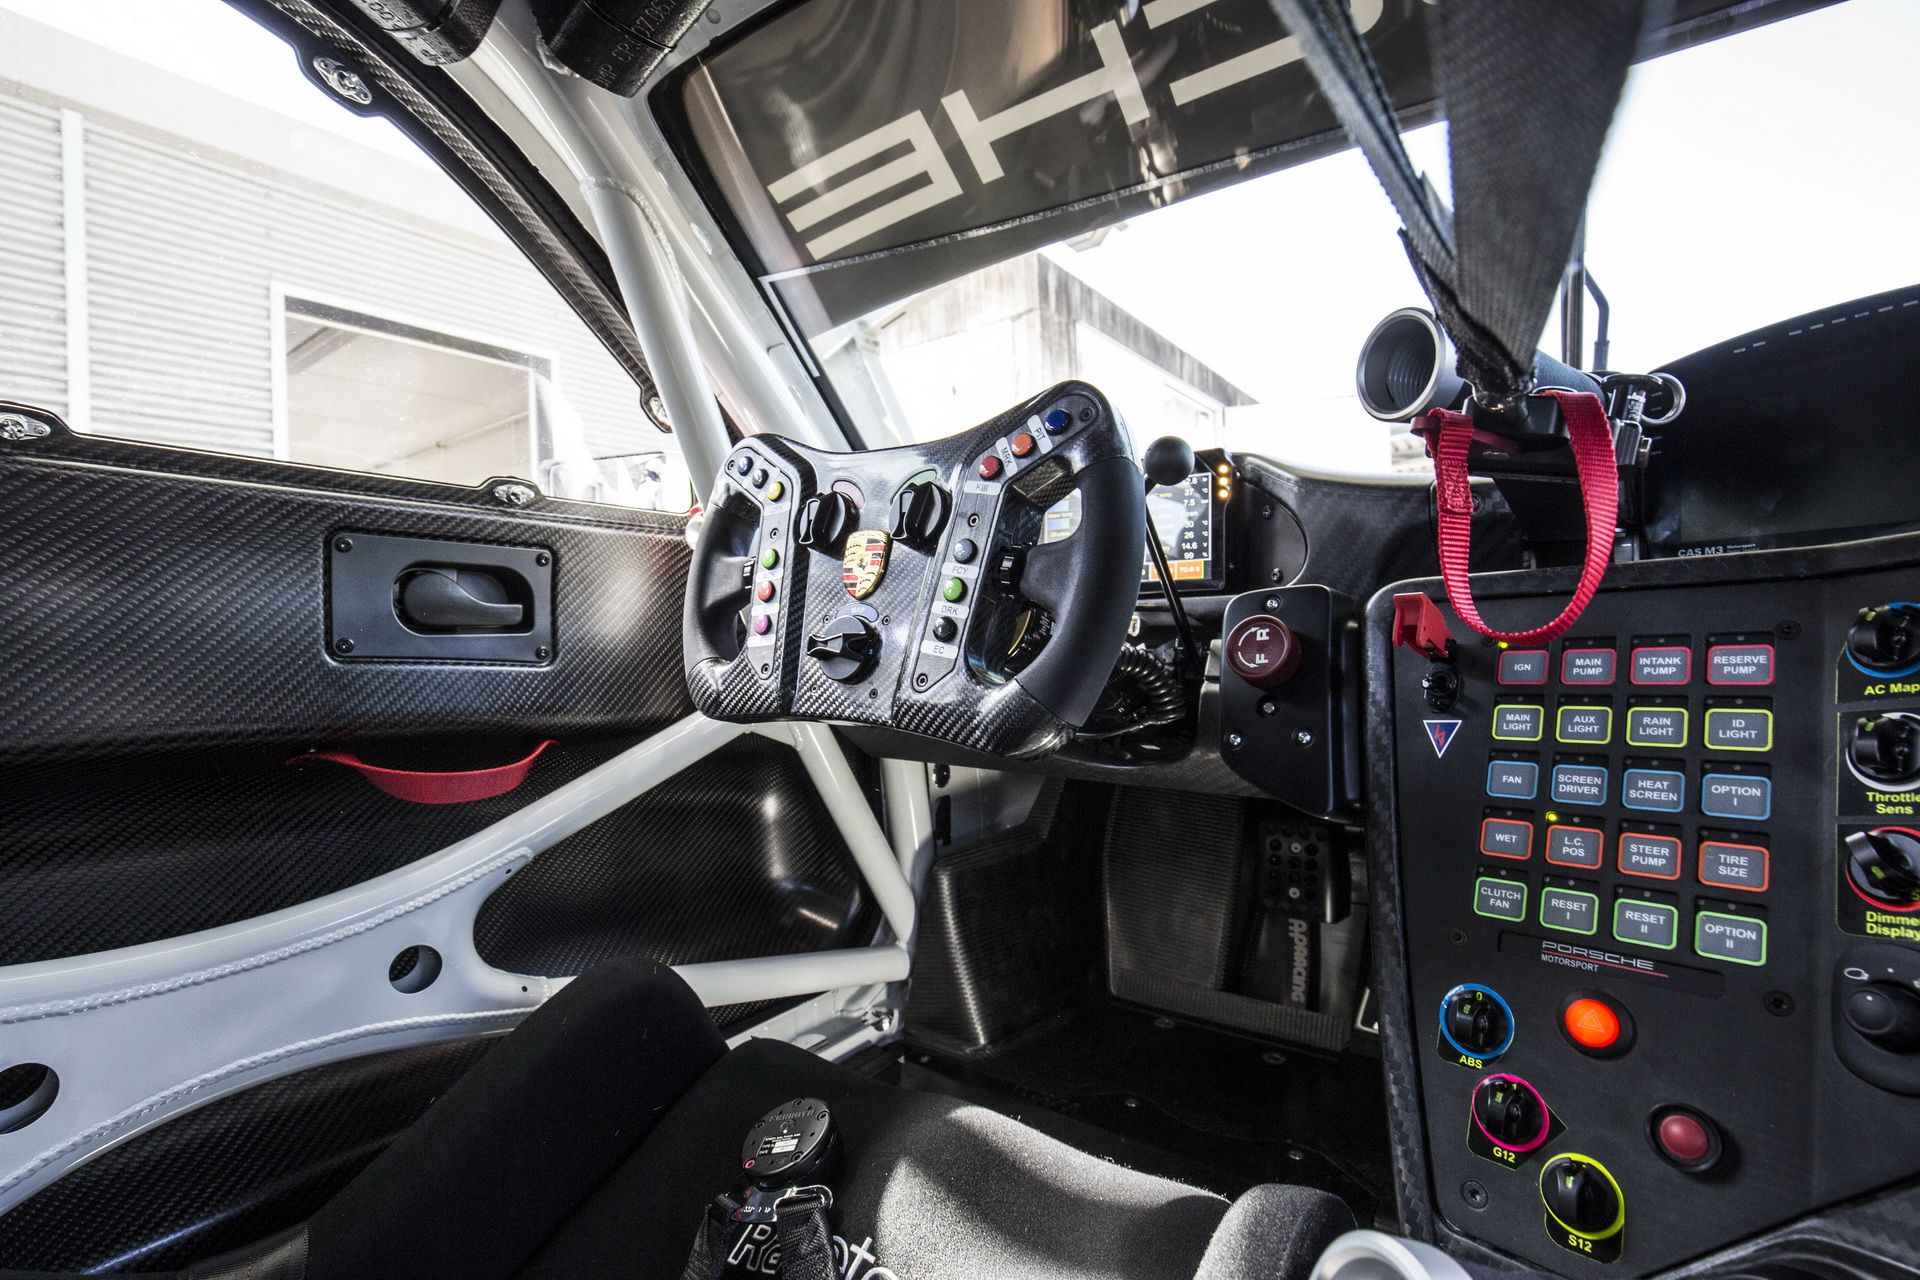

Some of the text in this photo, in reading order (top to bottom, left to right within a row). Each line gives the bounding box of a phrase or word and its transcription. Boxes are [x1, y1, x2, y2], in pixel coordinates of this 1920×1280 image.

[1034, 427, 1046, 441] PIT
[1000, 446, 1013, 465] MRK
[1184, 488, 1194, 496] 27
[1183, 498, 1195, 507] 7.5
[1184, 531, 1194, 539] 26
[1181, 541, 1198, 550] 14.6
[1677, 547, 1702, 558] CAS
[1704, 546, 1723, 556] M3
[952, 566, 968, 575] FCY
[941, 605, 958, 616] DRK
[1256, 628, 1270, 641] R
[933, 645, 945, 655] EC
[1256, 653, 1269, 664] F
[1575, 658, 1602, 666] MAIN
[1639, 657, 1682, 665] INTANK
[1713, 655, 1767, 664] RESERVE
[1514, 663, 1531, 671] IGN
[1573, 666, 1603, 675] PUMP
[1643, 666, 1677, 675] PUMP
[1723, 665, 1757, 674] PUMP
[1864, 682, 1920, 696] AC Map
[1506, 713, 1530, 721] MAIN
[1573, 715, 1596, 723] AUX
[1643, 716, 1671, 725] RAIN
[1503, 722, 1532, 731] LIGHT
[1568, 724, 1599, 733] LIGHT
[1732, 719, 1745, 728] ID
[1639, 726, 1674, 736] LIGHT
[1718, 729, 1757, 739] LIGHT
[1502, 775, 1522, 784] FAN
[1558, 774, 1602, 785] SCREEN
[1638, 780, 1670, 790] HEAT
[1559, 784, 1599, 795] DRIVER
[1628, 789, 1678, 801] SCREEN
[1711, 784, 1761, 797] OPTION
[1866, 791, 1920, 803] Throttle
[1875, 803, 1914, 815] Sens
[1495, 833, 1517, 843] WET
[1564, 836, 1584, 847] L.C.
[1562, 846, 1585, 857] POS
[1630, 844, 1670, 857] STEER
[1632, 855, 1667, 867] PUMP
[1718, 854, 1749, 866] TIRE
[1718, 865, 1748, 878] SIZE
[1480, 887, 1521, 901] CLUTCH
[1489, 898, 1510, 909] FAN
[1551, 898, 1587, 912] RESET
[1625, 911, 1666, 925] RESET
[1640, 924, 1648, 934] II
[1704, 923, 1757, 941] OPTION
[1866, 922, 1920, 942] Display
[1726, 939, 1734, 949] II
[1542, 940, 1655, 971] PORSCHE
[1540, 953, 1599, 973] MOTORSPORT
[1459, 1054, 1483, 1070] ABS
[1492, 1146, 1516, 1164] G12
[1568, 1234, 1593, 1253] S12
